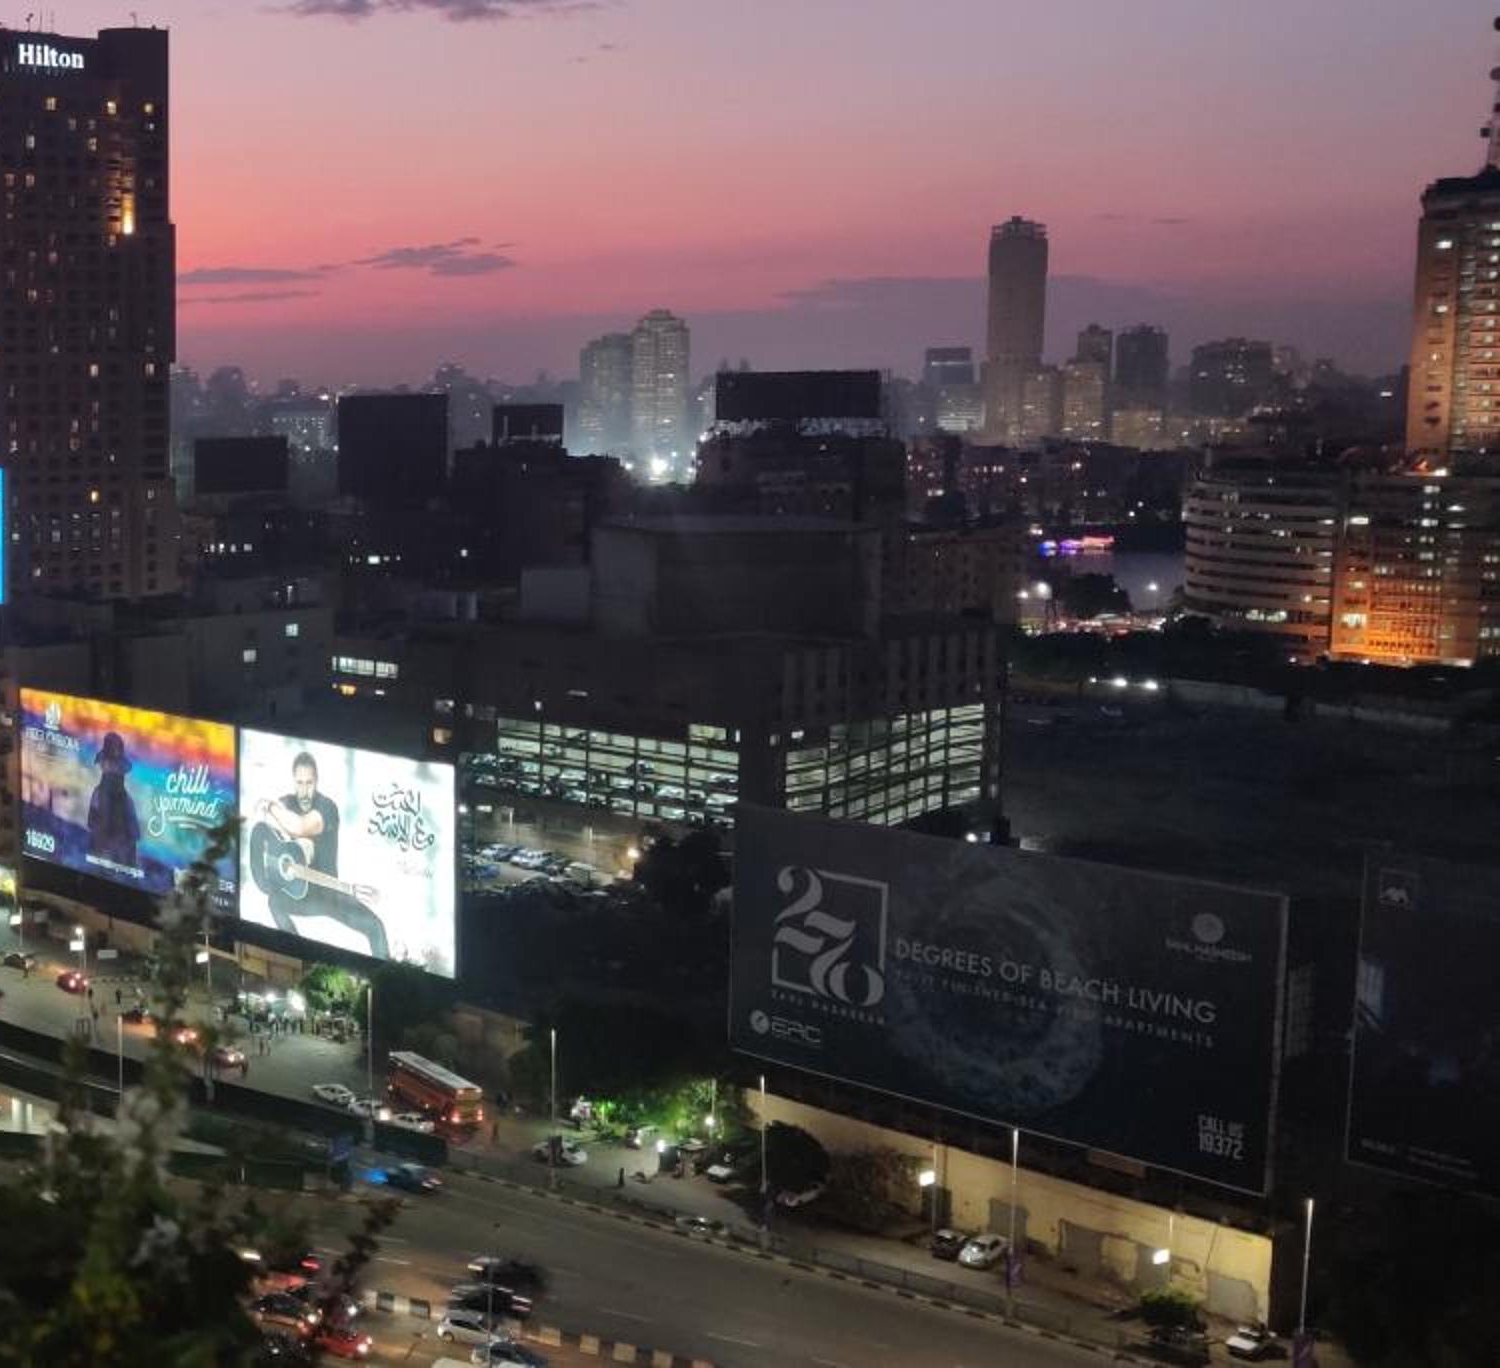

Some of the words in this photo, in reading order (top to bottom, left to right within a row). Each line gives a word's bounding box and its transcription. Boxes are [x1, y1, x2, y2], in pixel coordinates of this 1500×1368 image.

[18, 43, 84, 68] Hilton
[166, 765, 210, 794] chill
[894, 937, 994, 978] DEGREES
[999, 959, 1033, 984] OF
[1039, 969, 1120, 1006] BEACH
[1127, 986, 1218, 1024] LIVING
[1198, 1132, 1244, 1161] 19372
